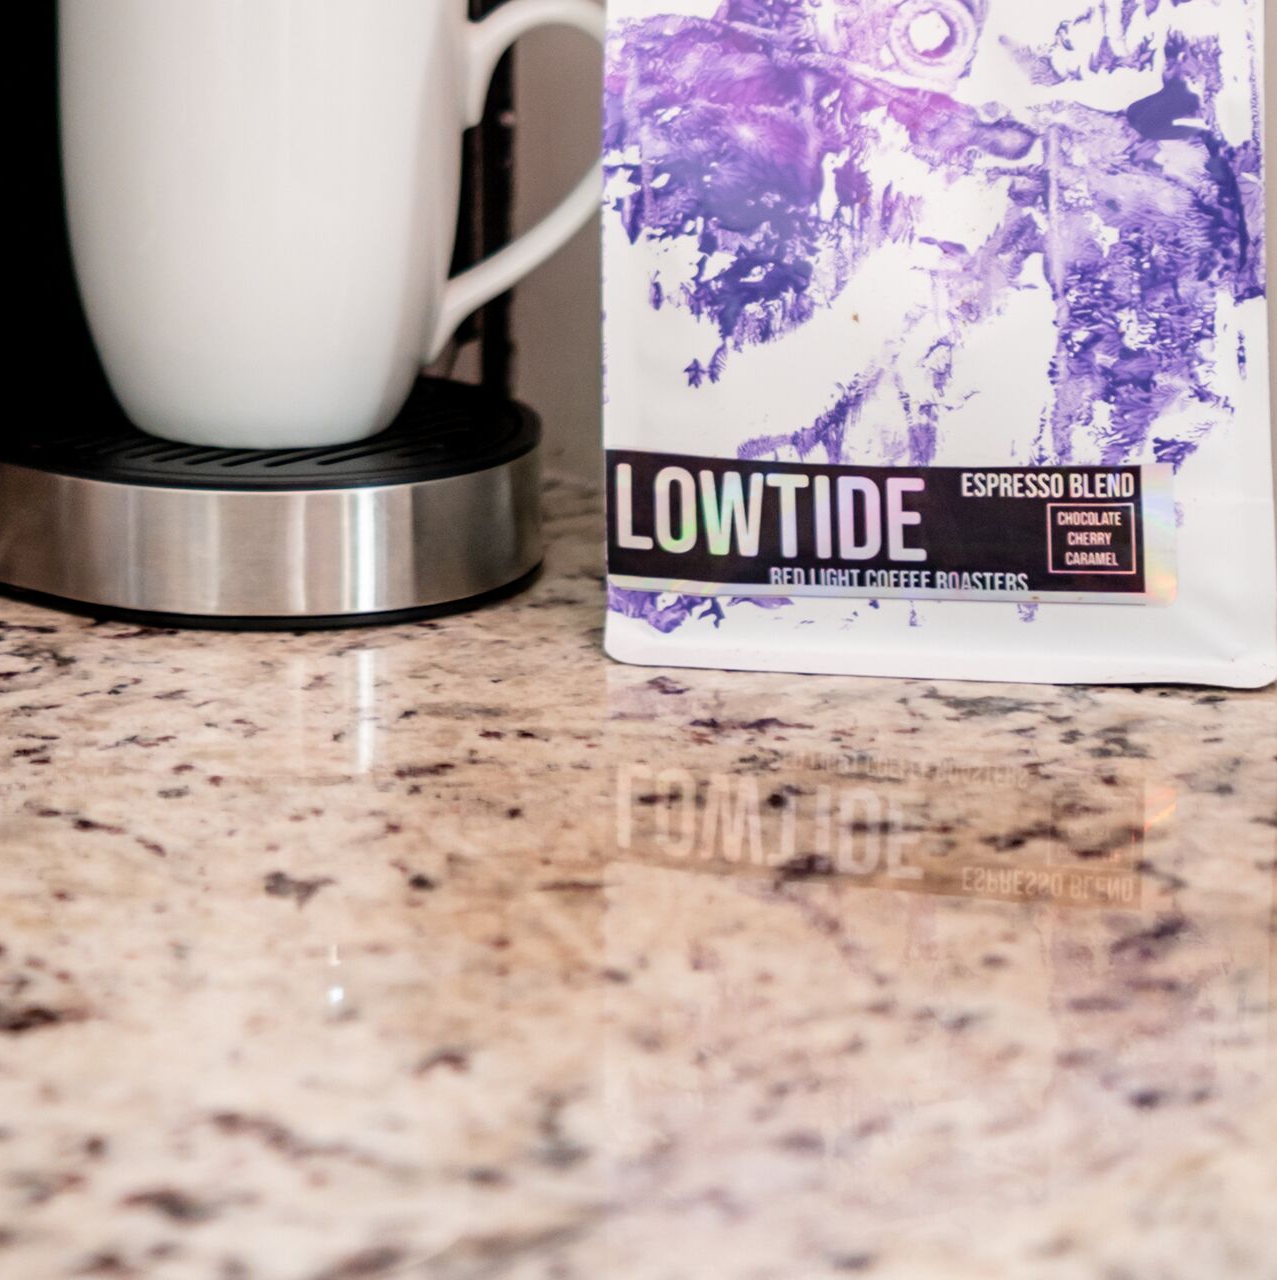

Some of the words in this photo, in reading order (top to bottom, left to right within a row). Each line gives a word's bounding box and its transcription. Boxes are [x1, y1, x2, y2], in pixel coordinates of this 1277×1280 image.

[961, 473, 1064, 498] ESPRESSO
[1069, 473, 1135, 498] BLEND
[615, 462, 928, 562] LOWTIDE
[1057, 511, 1123, 526] CHOCOLATE
[1067, 531, 1112, 546] CHERRY
[1065, 551, 1119, 566] CARAMEL
[770, 566, 805, 586] RED
[810, 568, 861, 587] LIGHT
[864, 569, 931, 589] COFFEE
[935, 570, 1029, 591] ROASTERS
